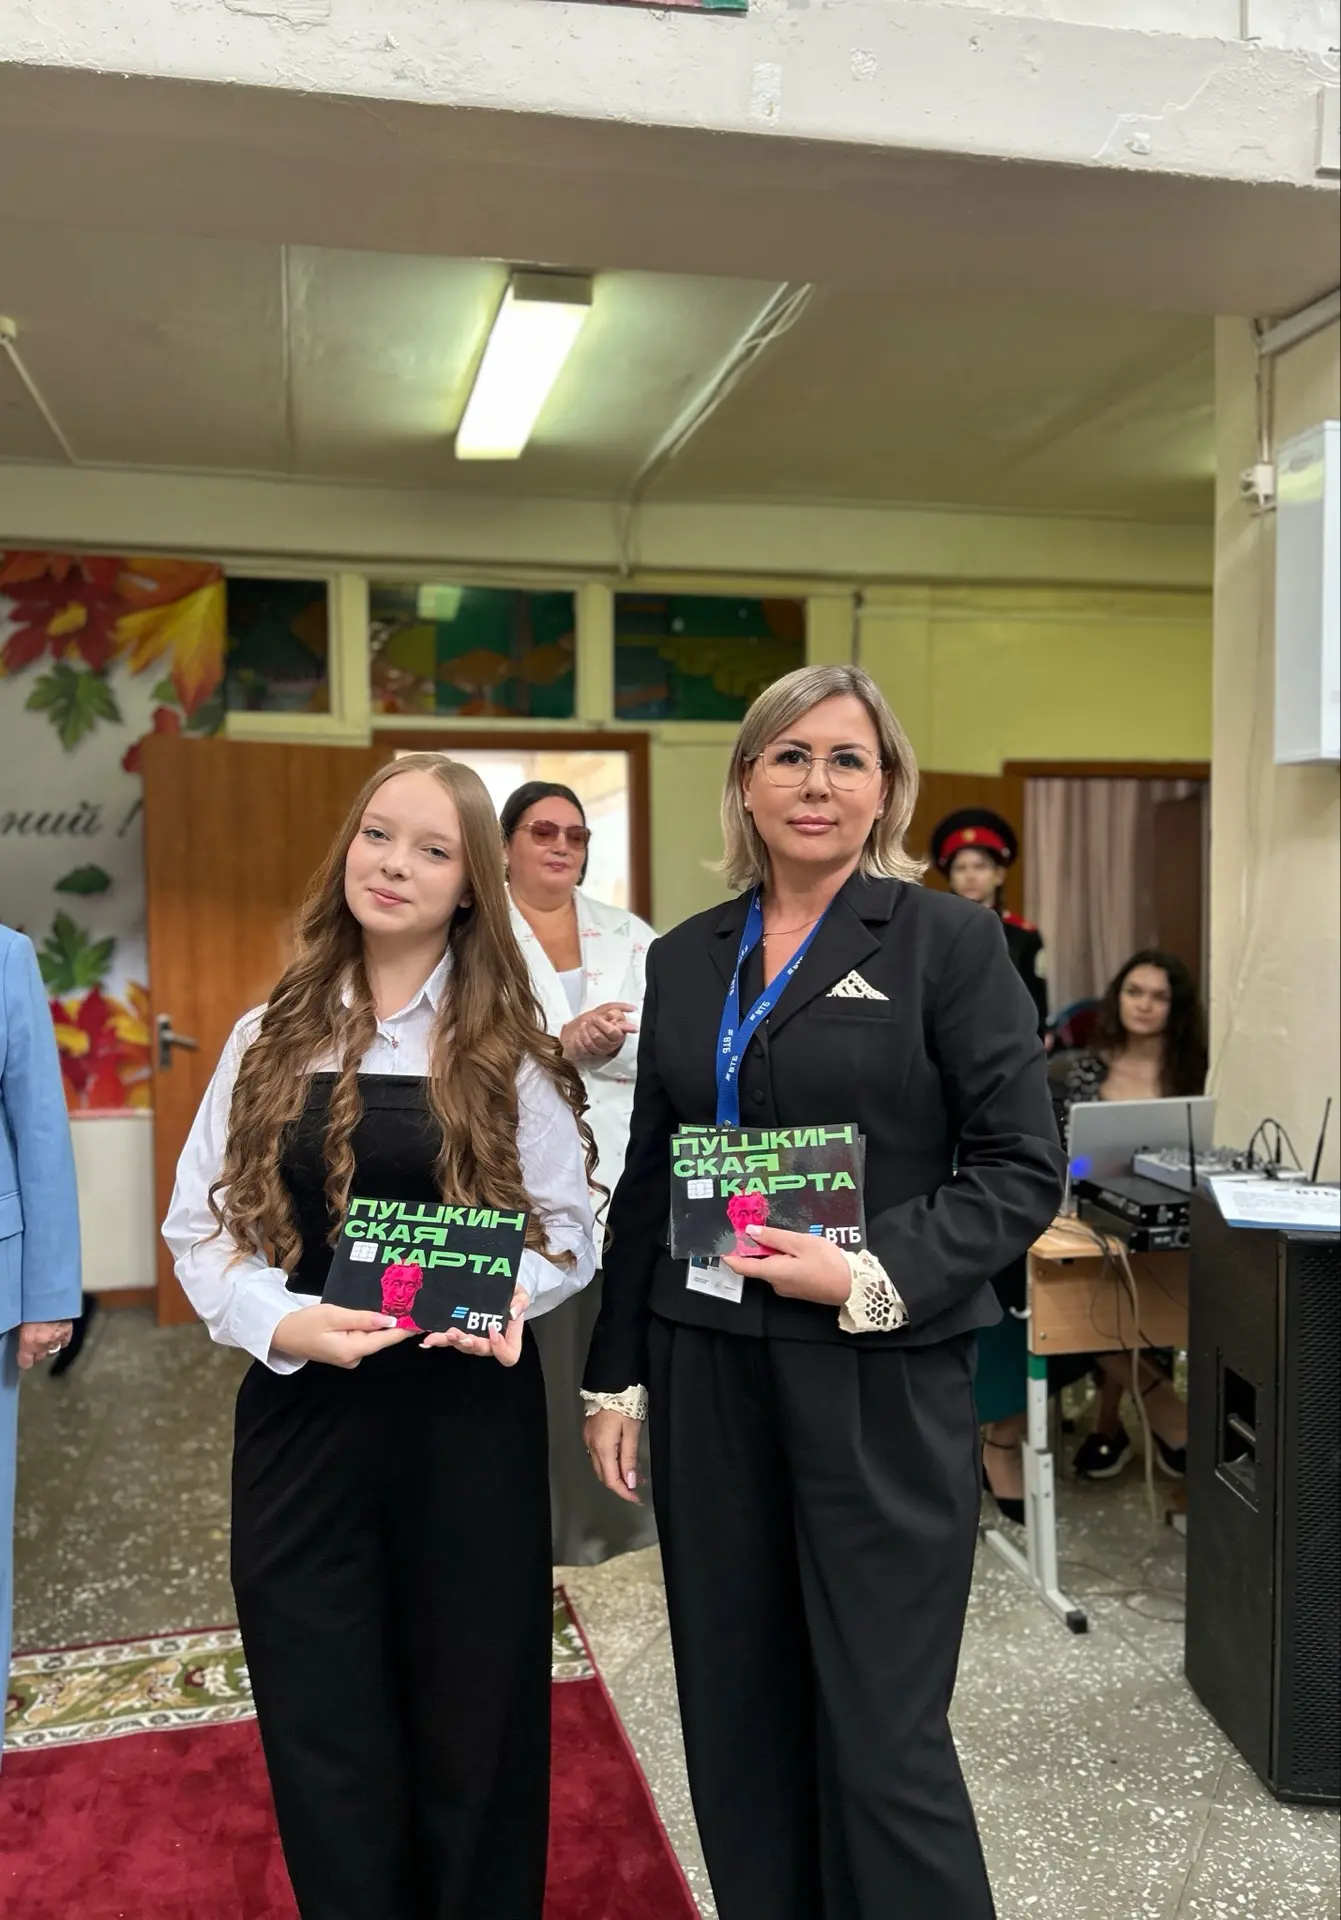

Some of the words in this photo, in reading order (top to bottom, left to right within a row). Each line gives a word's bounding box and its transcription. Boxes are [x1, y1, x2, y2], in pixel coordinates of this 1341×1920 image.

[755, 1000, 771, 1016] ВТБ
[722, 1036, 732, 1054] ВТБ
[728, 1055, 739, 1073] ВТБ
[672, 1126, 853, 1157] ПУШКИН
[673, 1153, 780, 1178] СКАЯ
[720, 1171, 856, 1197] КАРТА
[349, 1198, 526, 1231] ПУШКИН
[344, 1219, 449, 1247] СКАЯ
[825, 1226, 862, 1244] ВТБ
[380, 1245, 513, 1278] КАРТА
[466, 1311, 504, 1332] ВТБ
